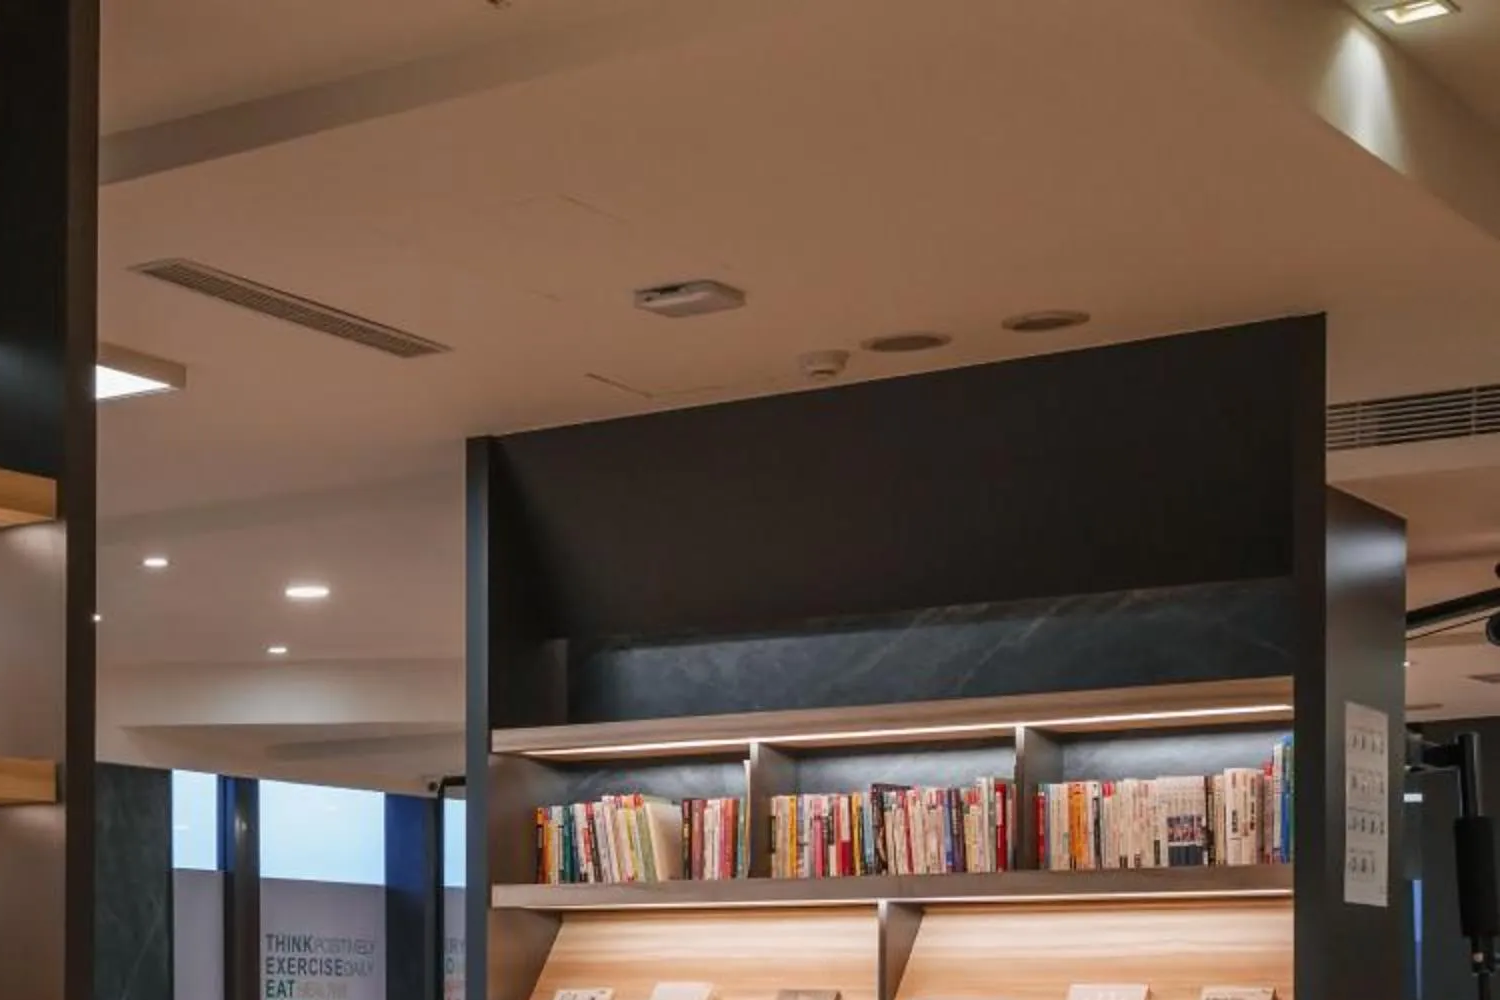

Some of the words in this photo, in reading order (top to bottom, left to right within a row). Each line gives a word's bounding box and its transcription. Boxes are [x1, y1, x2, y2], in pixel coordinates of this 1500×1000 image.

[265, 934, 313, 954] THINK
[265, 957, 343, 977] EXERCISE
[265, 979, 295, 998] EAT
